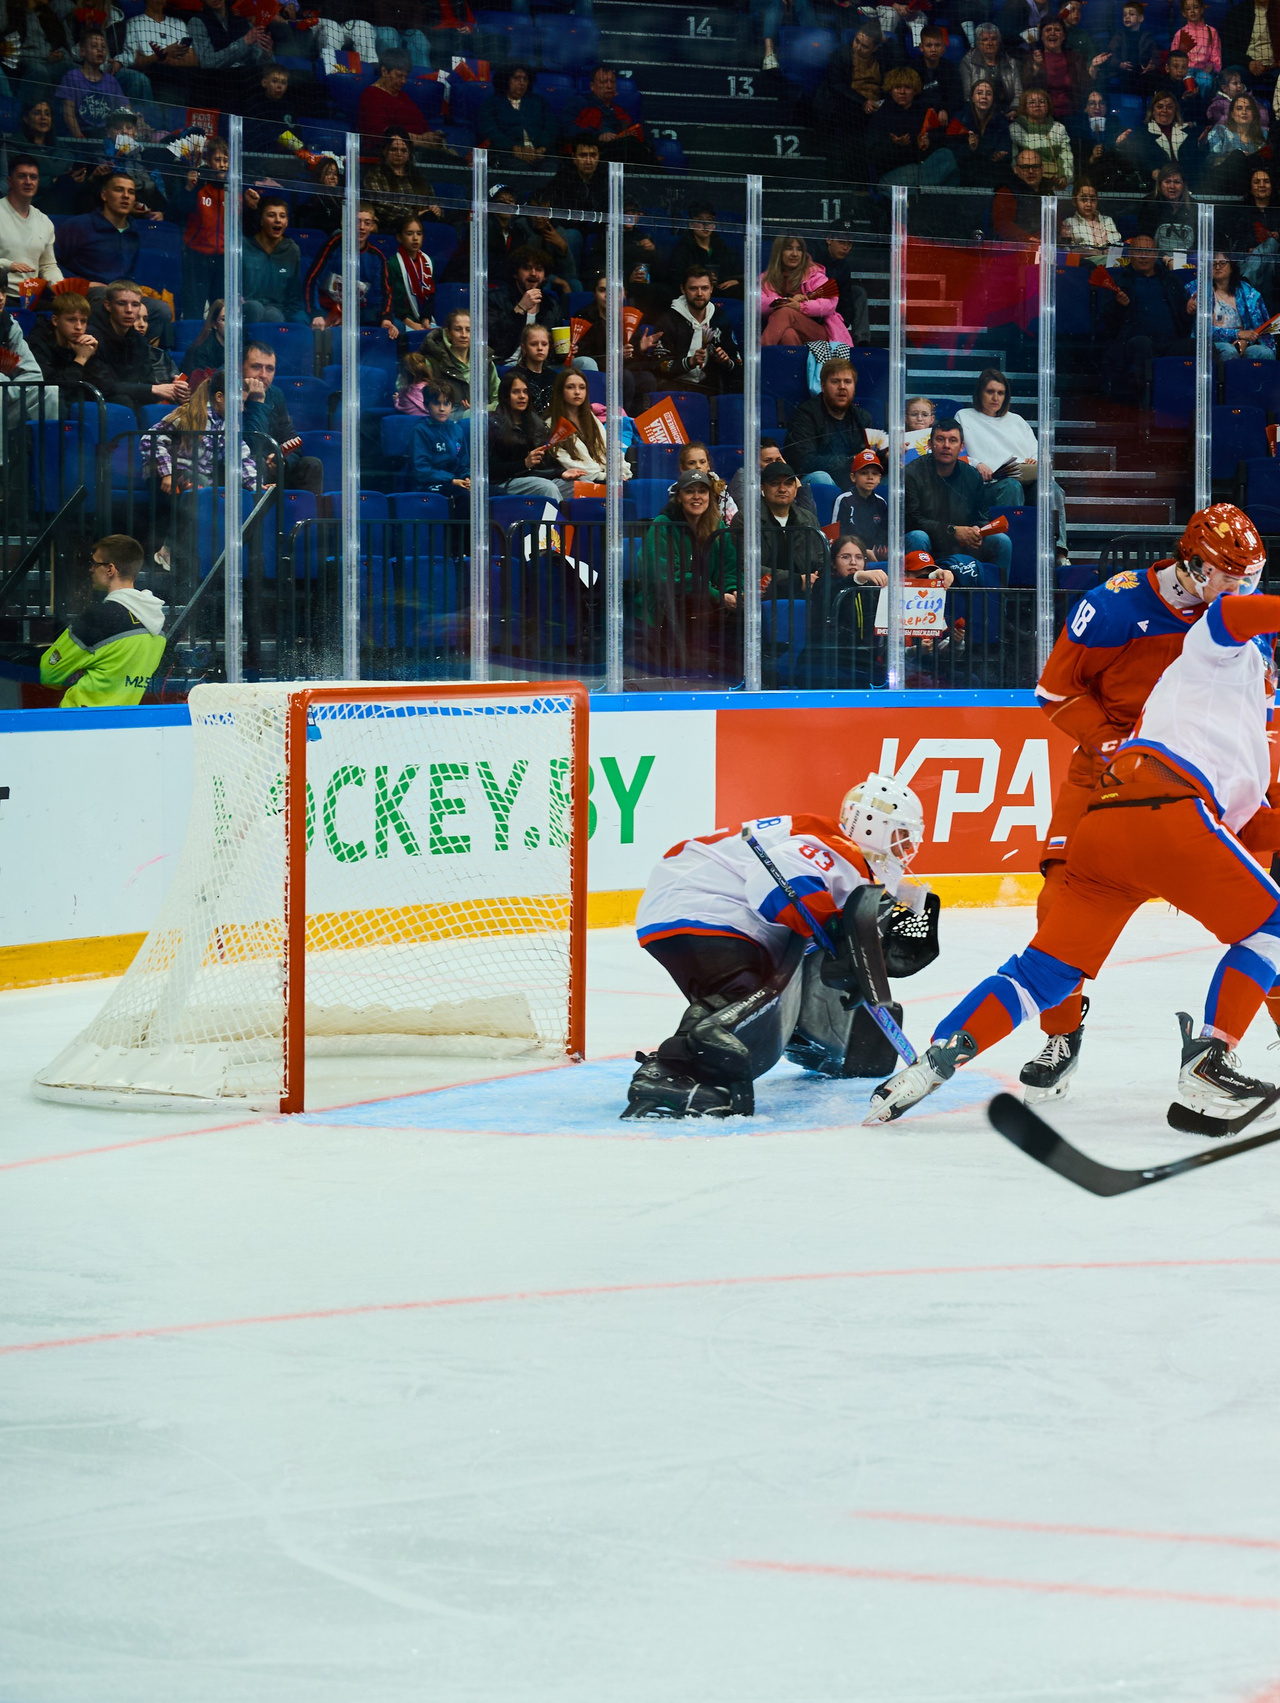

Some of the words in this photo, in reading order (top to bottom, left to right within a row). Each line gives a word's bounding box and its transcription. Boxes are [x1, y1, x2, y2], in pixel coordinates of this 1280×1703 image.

[686, 16, 712, 38] 14
[727, 75, 754, 97] 13
[773, 134, 800, 157] 12
[821, 199, 841, 220] 11
[1070, 599, 1096, 638] 18
[871, 738, 1054, 843] КРА
[798, 844, 835, 873] 83
